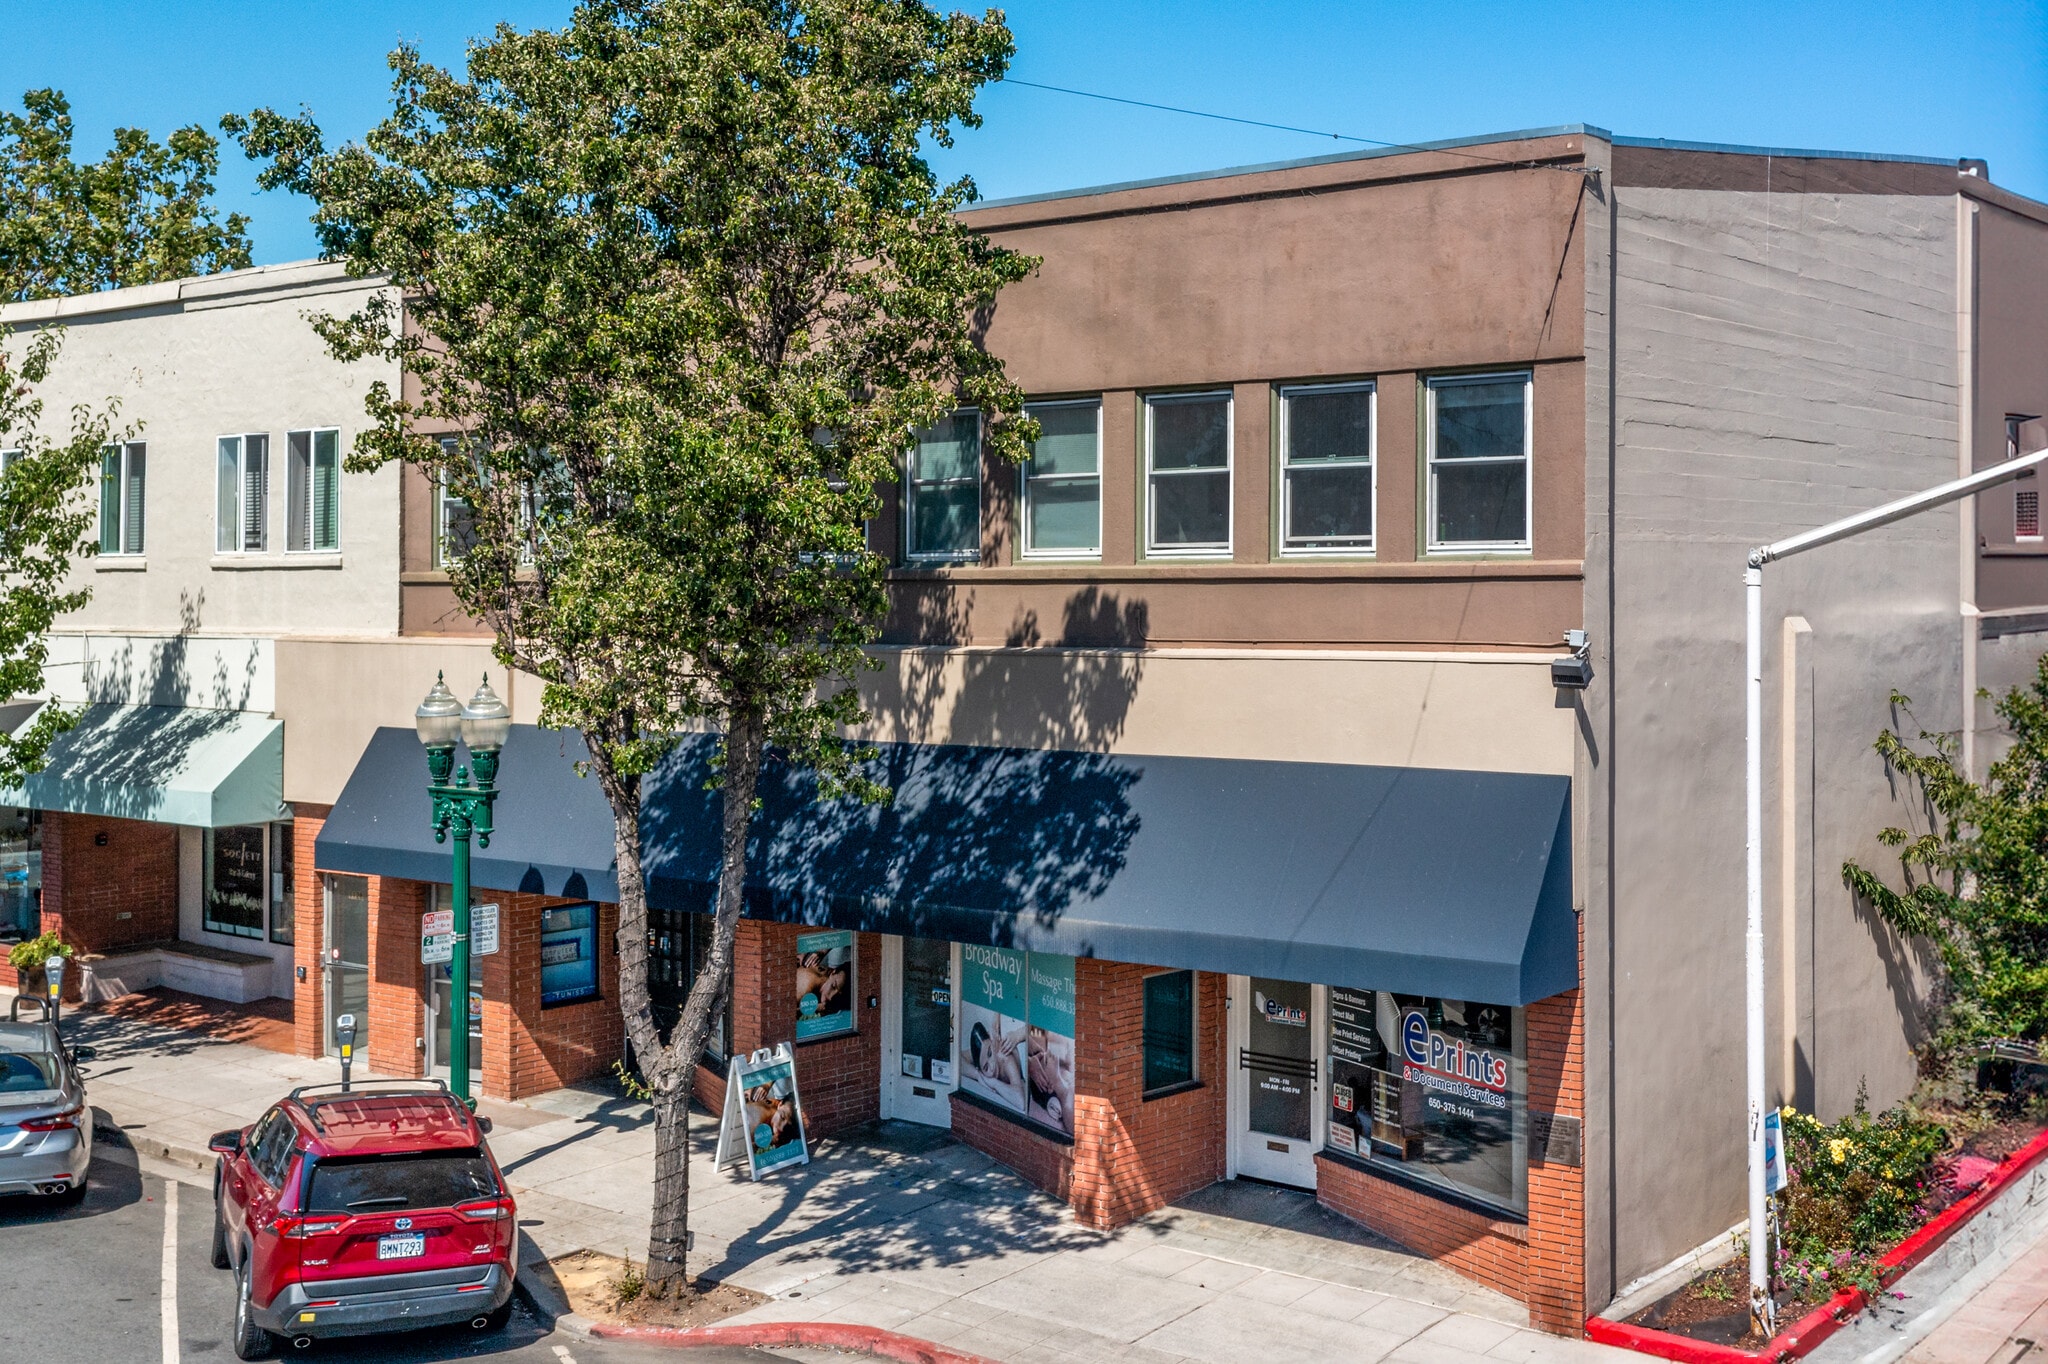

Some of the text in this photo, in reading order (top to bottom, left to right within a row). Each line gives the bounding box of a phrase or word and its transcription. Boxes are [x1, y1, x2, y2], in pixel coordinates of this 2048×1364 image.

[425, 913, 451, 923] NO PARKING
[965, 943, 1022, 1004] Broadway Spa
[1031, 968, 1063, 995] Massage
[1332, 990, 1344, 1001] Signs
[1348, 994, 1366, 1007] Banners
[1332, 1008, 1355, 1021] Direct Mail
[1342, 1029, 1352, 1040] Print
[1353, 1032, 1371, 1045] Services
[1332, 1044, 1361, 1062] Offset Printing
[1403, 1011, 1507, 1088] ePrints
[1260, 1082, 1270, 1090] 9:00
[1335, 1086, 1352, 1097] CLOSED
[1403, 1065, 1506, 1108] & Document Services
[1428, 1097, 1474, 1119] 650-375 1444
[390, 1232, 414, 1240] TOYOTA
[381, 1241, 422, 1256] 8MNT293
